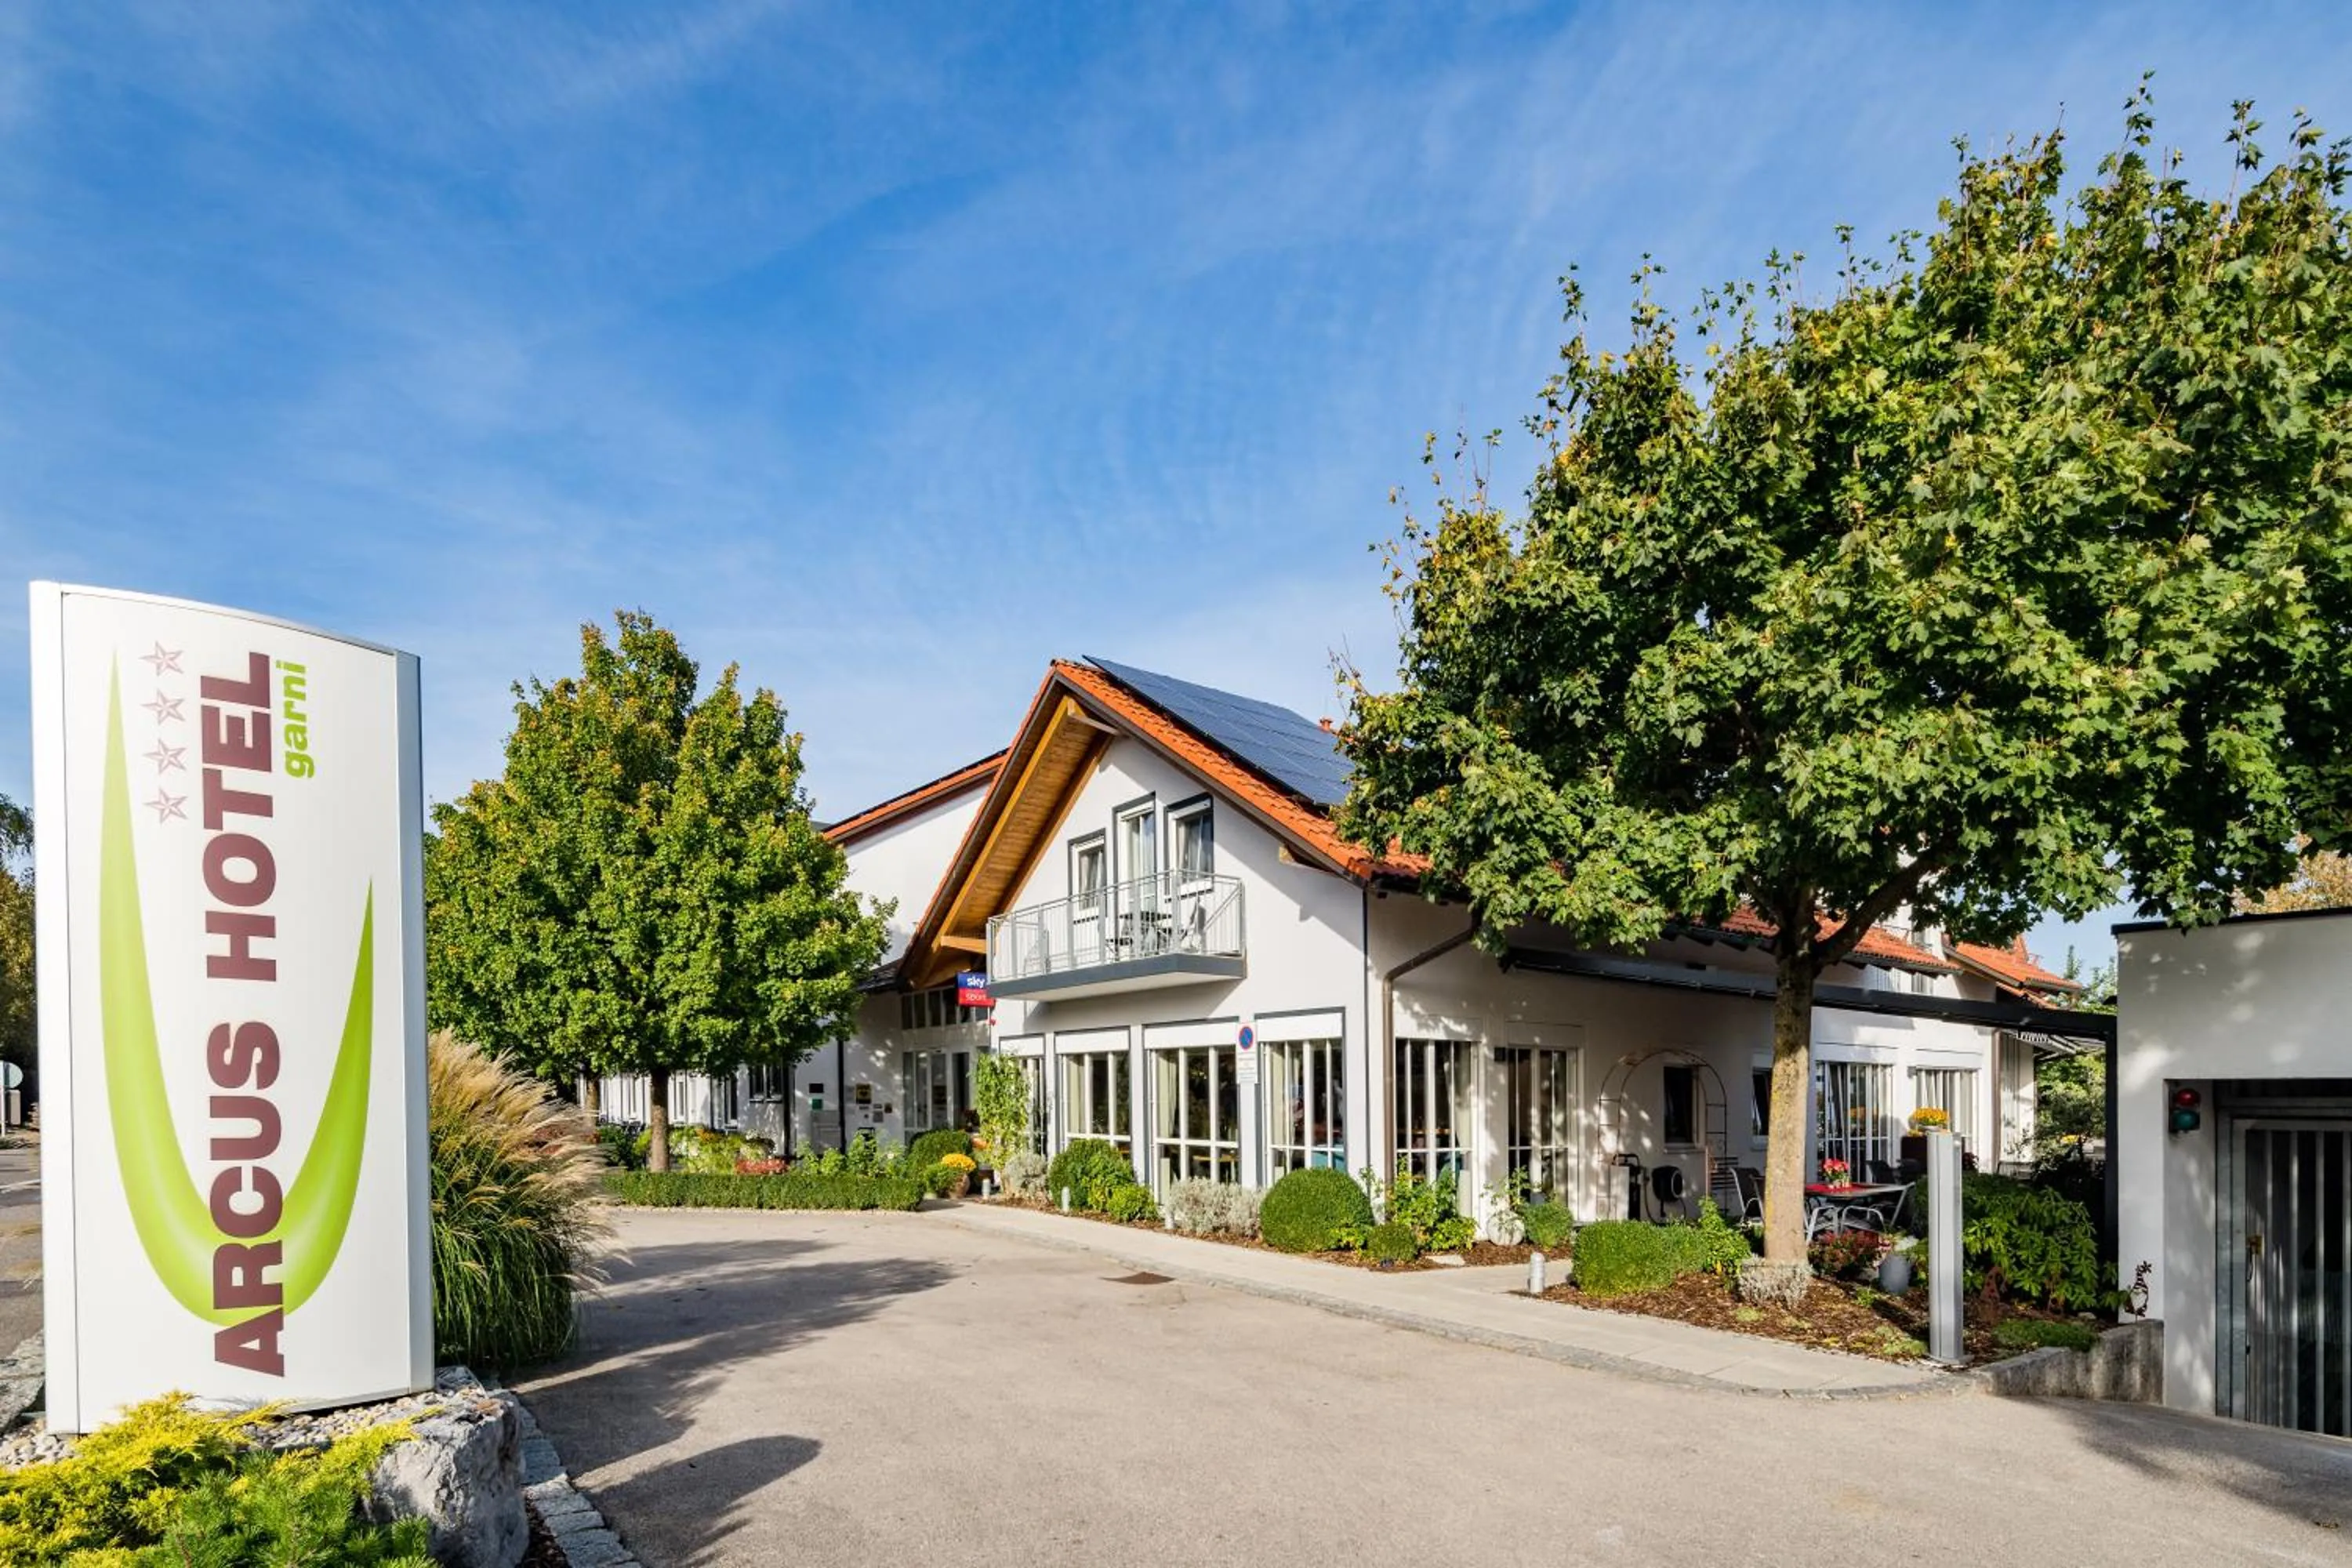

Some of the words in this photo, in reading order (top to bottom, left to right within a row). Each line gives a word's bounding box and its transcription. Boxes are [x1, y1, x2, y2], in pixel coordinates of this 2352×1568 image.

[200, 652, 277, 982] HOTEL
[275, 660, 315, 779] garni
[967, 975, 985, 989] sky
[206, 1020, 285, 1377] ARCUS
